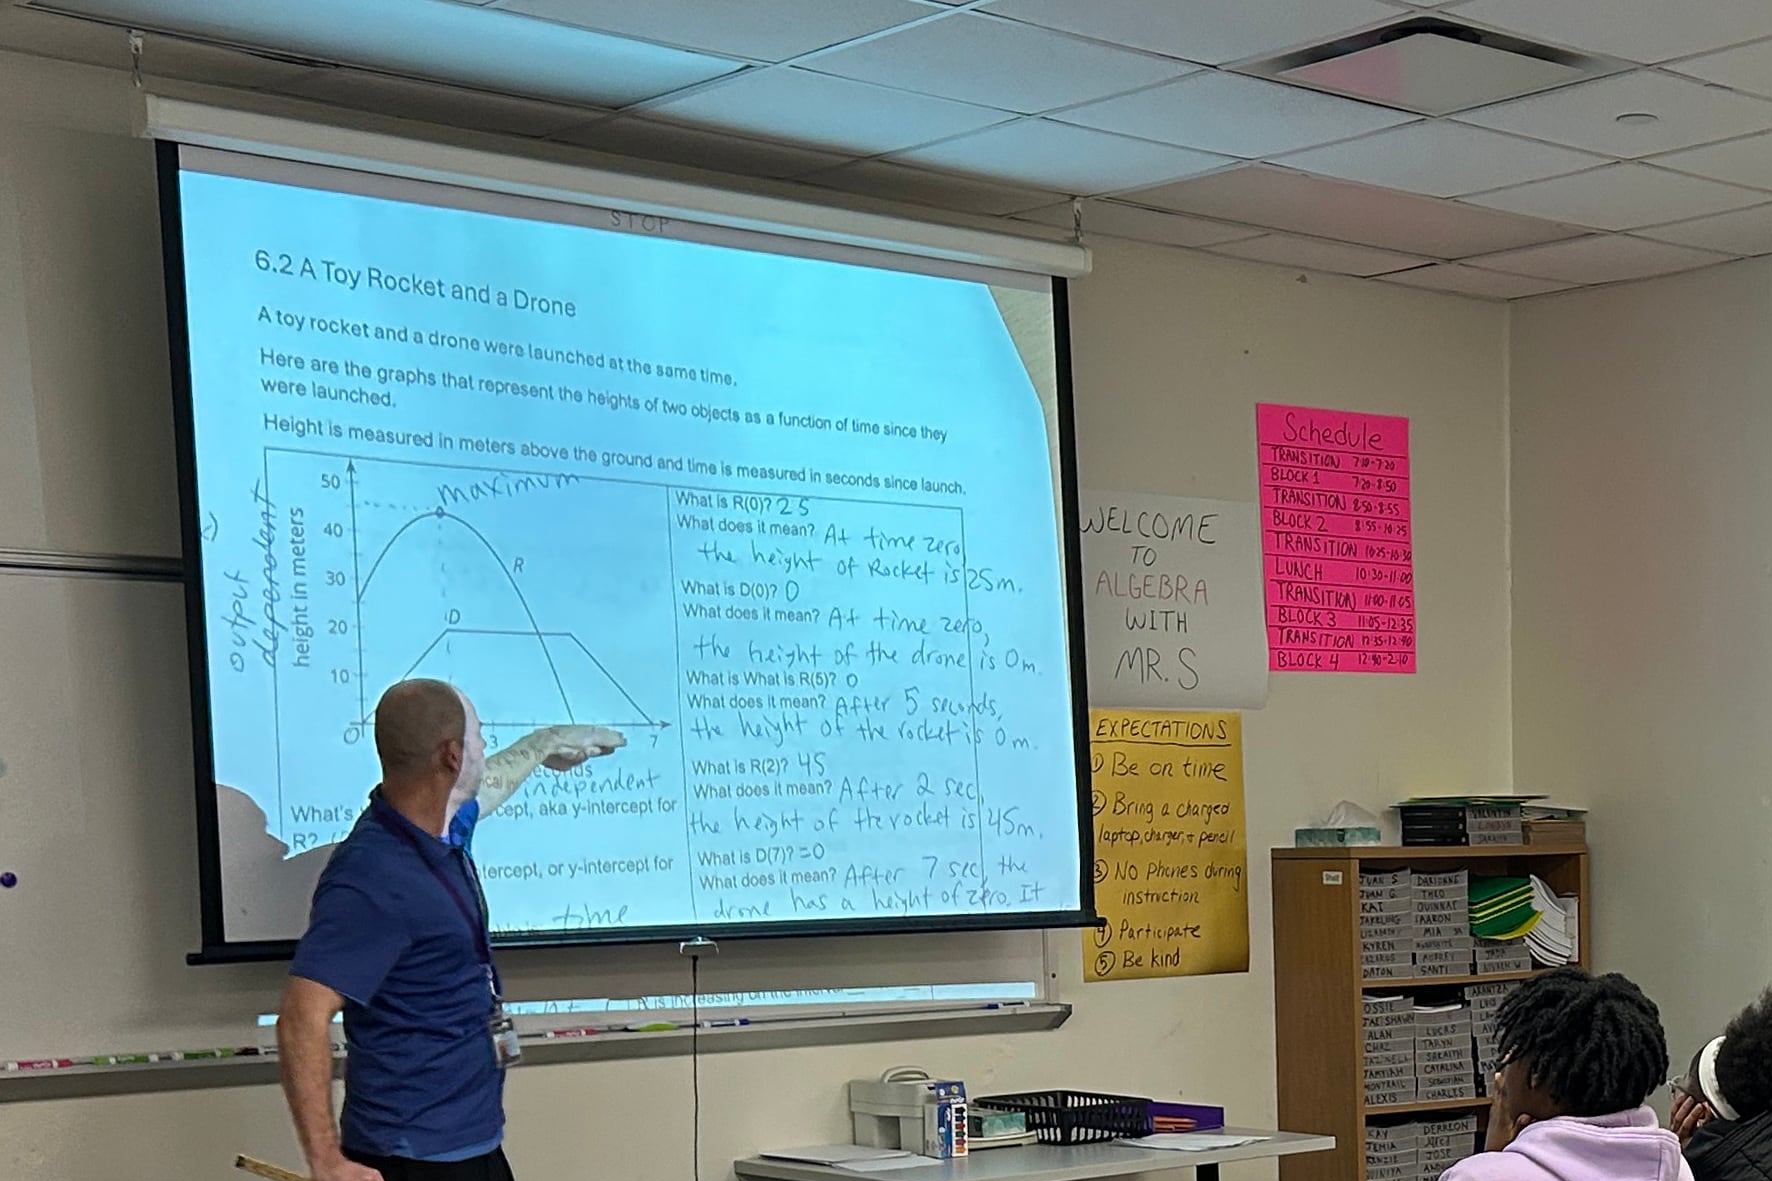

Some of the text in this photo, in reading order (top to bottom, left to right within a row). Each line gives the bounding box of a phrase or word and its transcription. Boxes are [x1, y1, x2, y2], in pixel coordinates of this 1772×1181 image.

[613, 209, 670, 231] STOP
[255, 249, 576, 317] 6.2 A Toy Rocket and a Drone
[258, 305, 737, 387] A toy rocket and a drone were launched at the same time.
[260, 378, 396, 408] were launched.
[260, 347, 948, 444] Here are the graphs that represent the heights of two objects as a function of time since they
[1283, 412, 1384, 451] Schedule
[263, 413, 966, 495] Height is measured in meters above the ground and time is measured in seconds since launch.
[437, 471, 581, 506] maximum
[1271, 466, 1320, 484] BLOCK 1
[675, 490, 713, 508] What
[717, 494, 728, 509] is
[733, 495, 772, 515] R(0)?
[677, 513, 715, 532] What
[718, 518, 753, 533] does
[757, 519, 766, 534] it
[770, 523, 815, 537] mean?
[824, 523, 849, 546] At
[864, 529, 915, 551] time
[1080, 507, 1218, 544] WELCOME
[1270, 506, 1328, 532] BLOCK 2
[1131, 546, 1157, 567] TO
[1276, 557, 1322, 581] LUNCH
[290, 506, 315, 668] height in meters
[1096, 571, 1208, 605] ALGEBRA
[221, 570, 257, 673] output
[1126, 607, 1187, 634] WITH
[1276, 605, 1336, 627] BLOCK 3
[1115, 647, 1199, 690] MR. S
[1278, 651, 1339, 671] BLOCK 4
[1096, 718, 1227, 740] EXPECTATIONS
[1111, 751, 1228, 782] Be on time
[1112, 791, 1230, 825] Bring a charged
[1205, 861, 1242, 892] during
[1123, 889, 1199, 905] instruction
[1119, 918, 1201, 941] Participate
[1123, 946, 1180, 968] Be kind
[1367, 1029, 1392, 1040] ALAN
